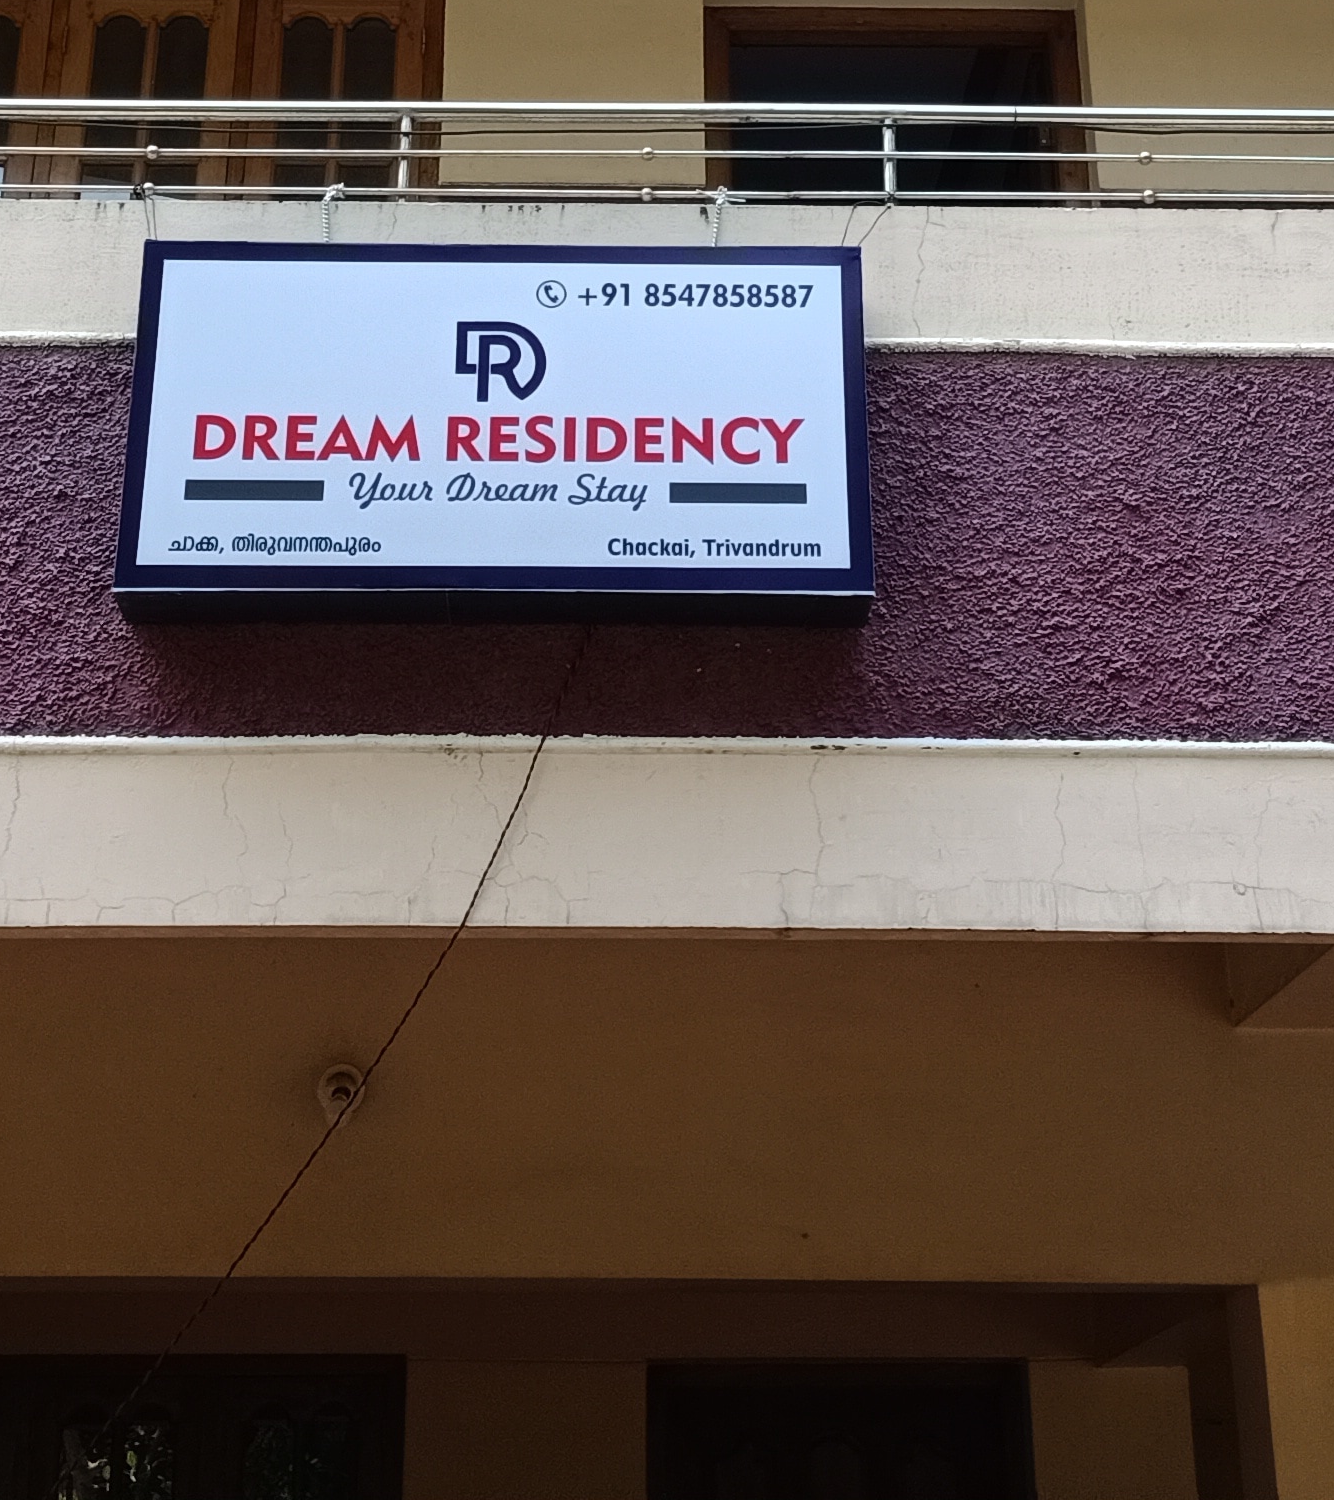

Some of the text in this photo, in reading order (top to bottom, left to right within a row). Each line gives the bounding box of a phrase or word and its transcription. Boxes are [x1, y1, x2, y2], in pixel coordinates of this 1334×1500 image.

[577, 282, 814, 309] +91 8547858587
[193, 415, 806, 465] DREAM RESIDENCY
[348, 472, 649, 512] Your Dream Stay
[167, 533, 382, 556] ചാക്ക, തിരുവനന്തപുരം
[607, 537, 822, 559] Chackai, Trivandrum
